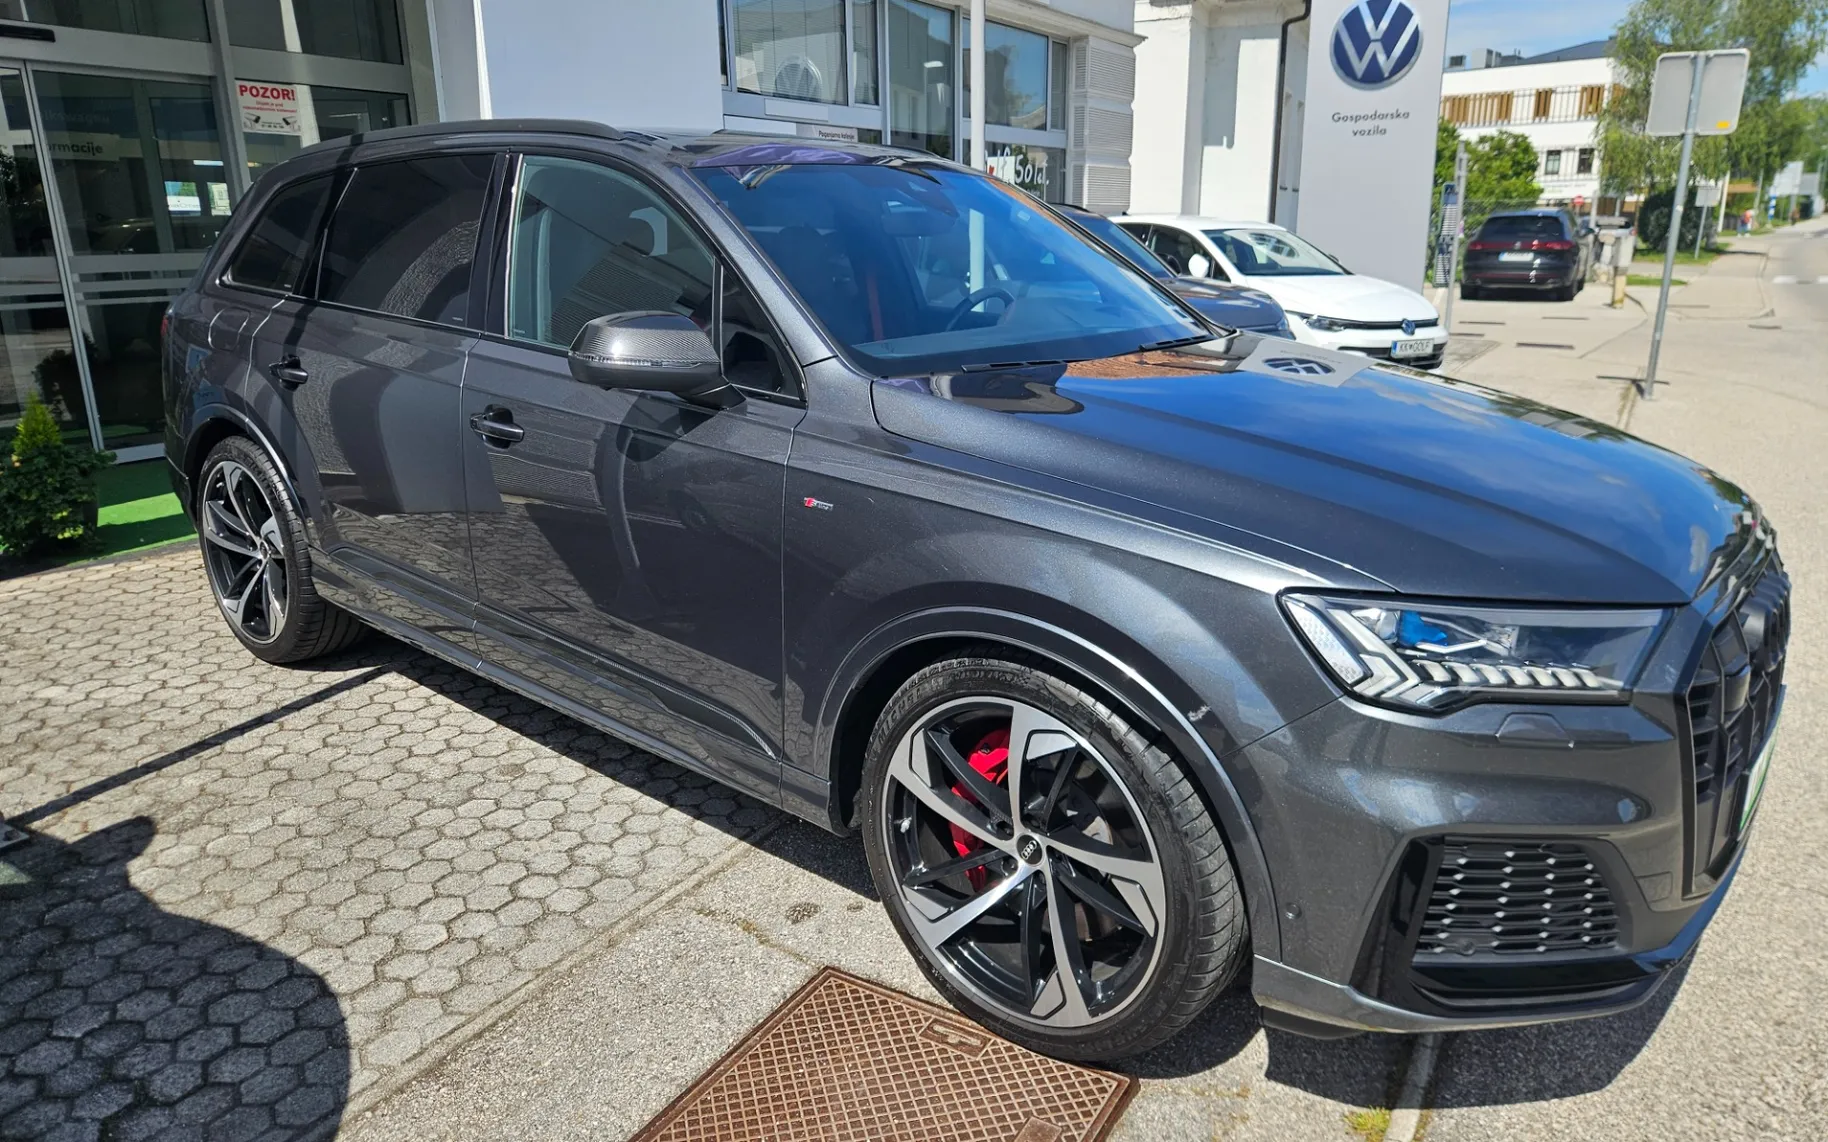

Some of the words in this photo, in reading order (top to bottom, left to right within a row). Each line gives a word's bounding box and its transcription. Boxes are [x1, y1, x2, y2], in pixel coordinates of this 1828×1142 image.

[238, 84, 296, 101] POZOR!
[1331, 108, 1410, 123] Gospodarska
[1352, 125, 1387, 137] vozila
